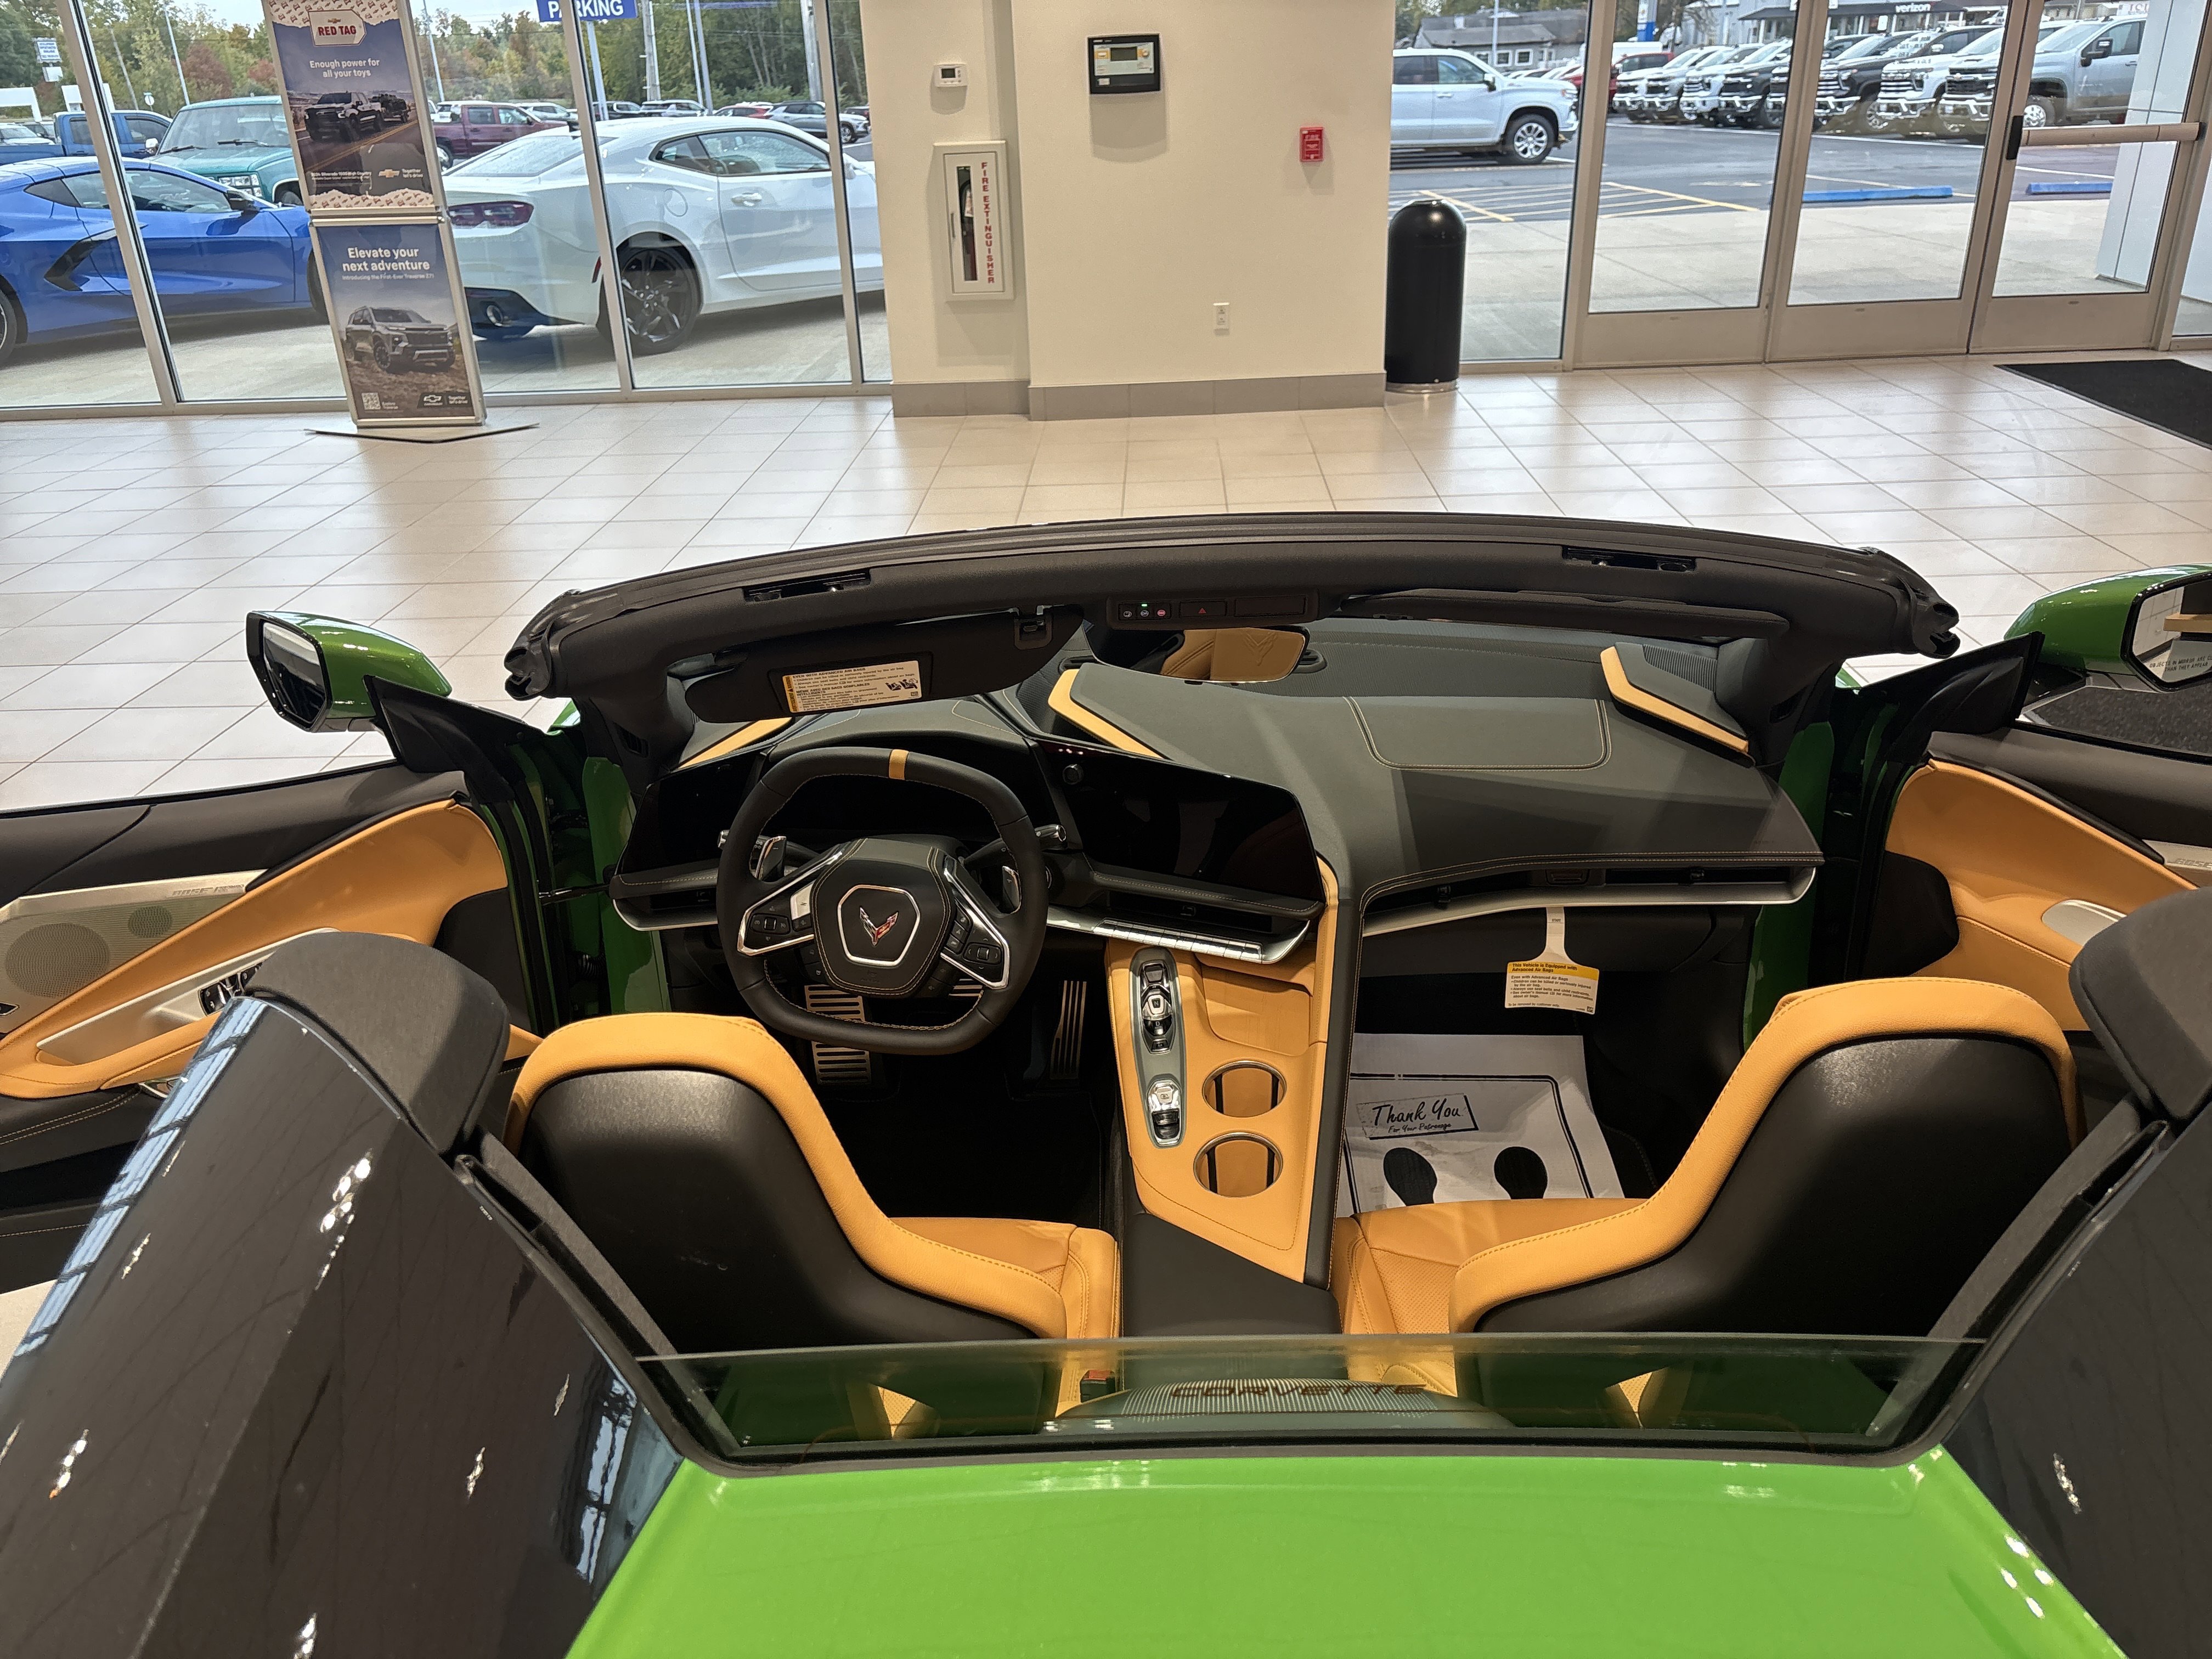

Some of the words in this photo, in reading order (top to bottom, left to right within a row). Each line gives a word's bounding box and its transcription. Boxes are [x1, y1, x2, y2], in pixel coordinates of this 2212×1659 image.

[548, 0, 624, 19] PRKING
[318, 26, 337, 36] RED
[338, 25, 357, 36] TAG
[309, 59, 340, 69] Enough
[341, 60, 366, 69] power
[368, 58, 380, 66] for
[323, 69, 332, 78] all
[353, 69, 371, 78] toys
[981, 162, 989, 192] FIRE
[983, 195, 995, 284] EXTINGUISHER
[347, 247, 391, 258] Elevate
[392, 248, 419, 259] your
[342, 261, 369, 272] next
[370, 260, 431, 271] adventure
[1372, 1101, 1426, 1126] Thank
[1432, 1098, 1460, 1120] You
[1388, 1125, 1400, 1133] For
[1402, 1124, 1417, 1133] Your
[1419, 1123, 1452, 1131] Patronage
[1171, 1383, 1427, 1398] CORVETTE
